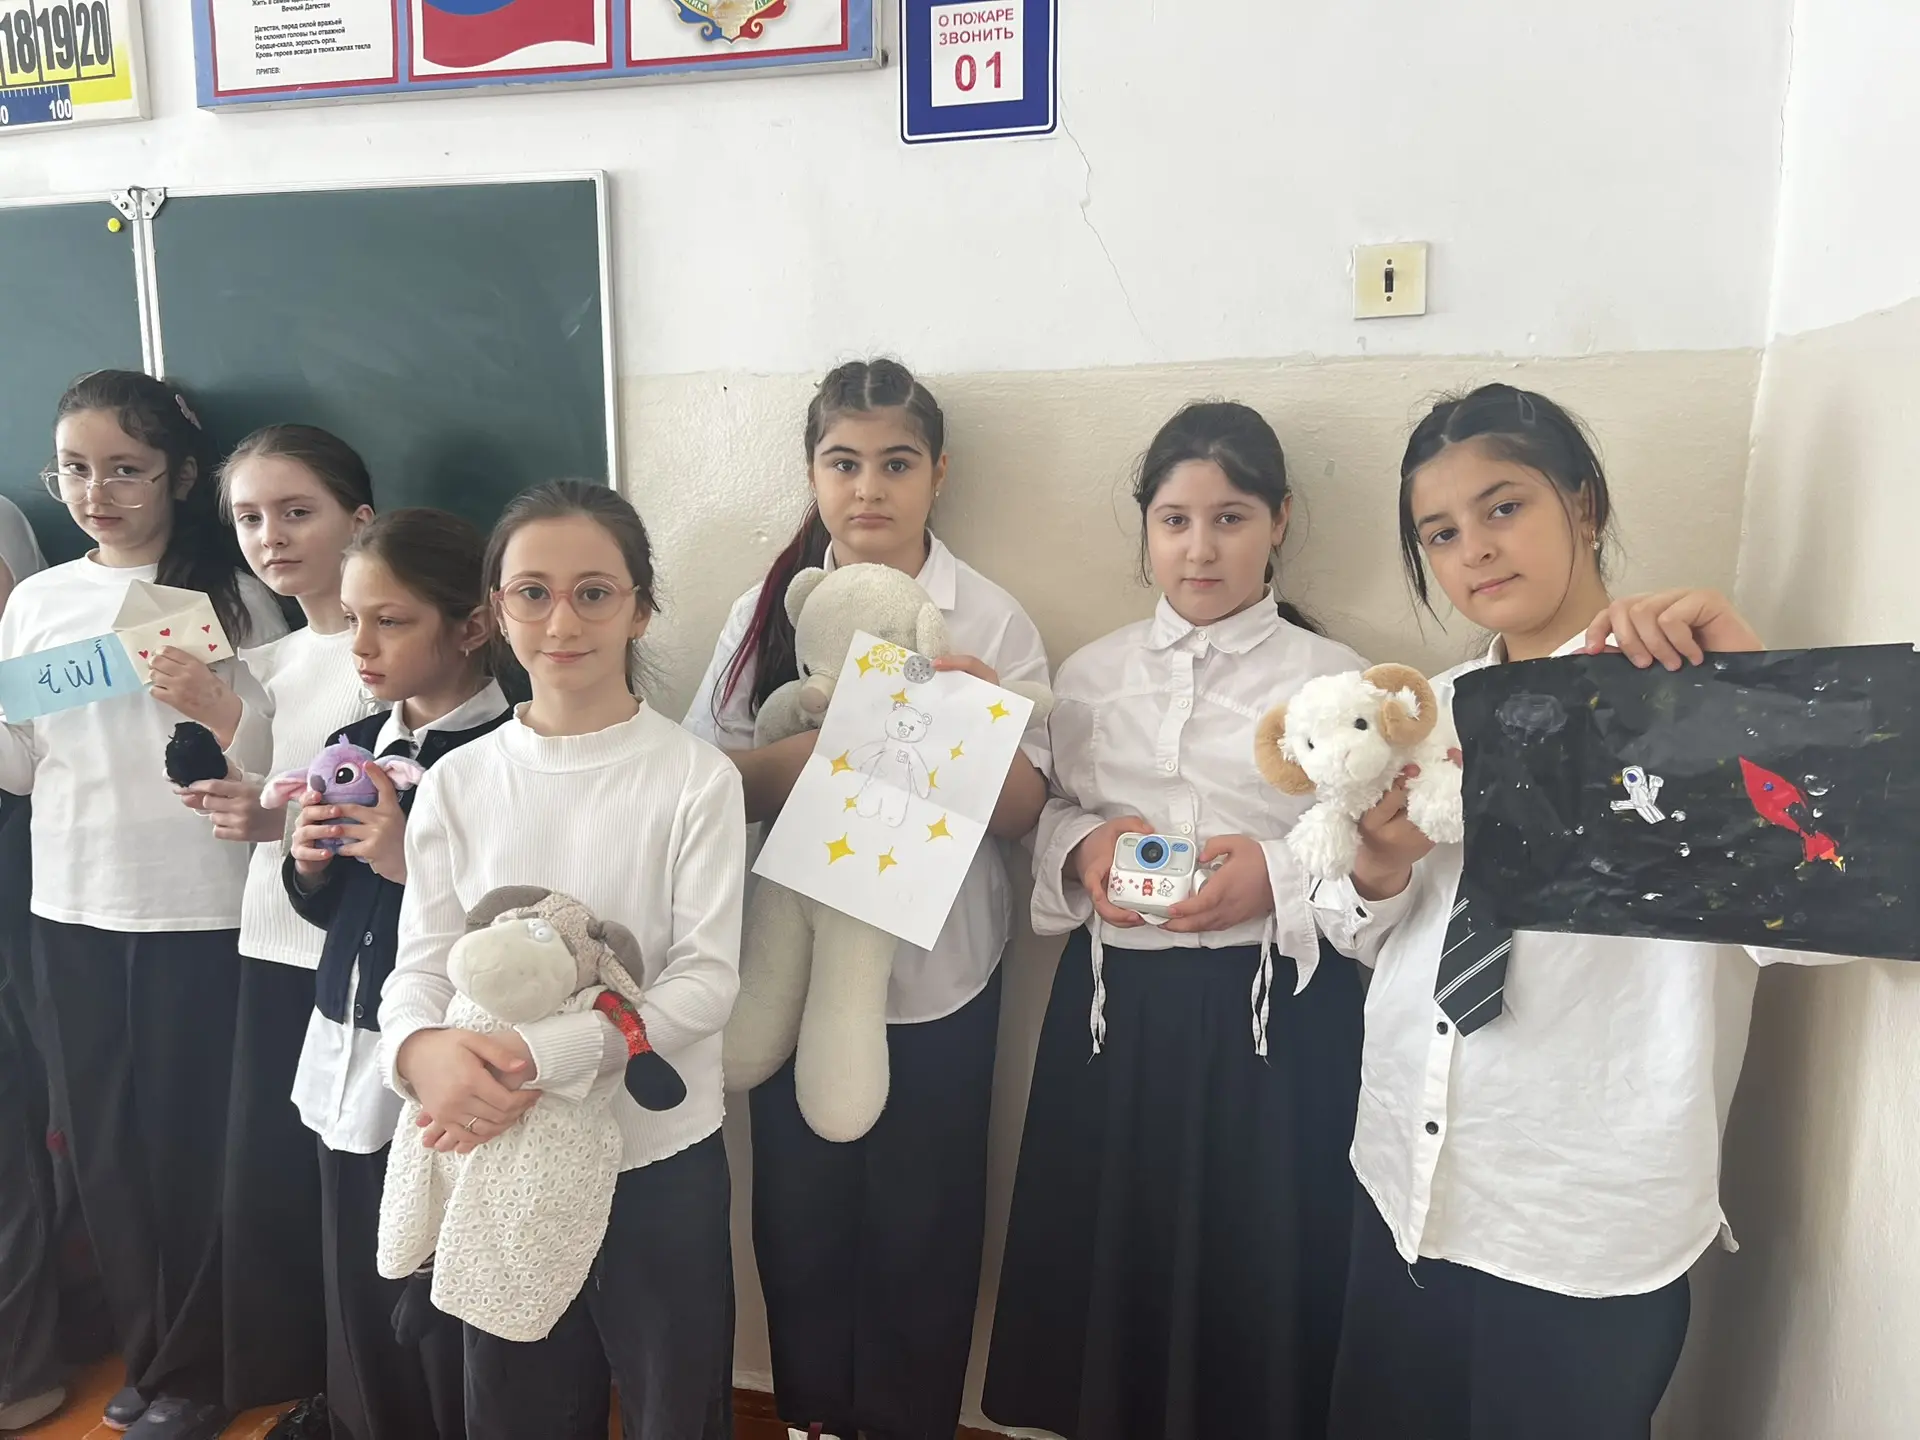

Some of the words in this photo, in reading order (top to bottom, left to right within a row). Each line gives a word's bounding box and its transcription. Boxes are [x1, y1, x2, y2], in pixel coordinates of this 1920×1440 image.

[281, 4, 304, 12] Вечный
[305, 3, 330, 11] Дагестан
[939, 15, 949, 27] О
[953, 8, 1014, 26] ПОЖАРЕ
[281, 23, 299, 31] перед
[299, 20, 316, 28] силой
[317, 18, 342, 27] вражьей
[318, 27, 345, 35] отважной
[939, 27, 1014, 46] ЗВОНИТЬ
[0, 9, 36, 74] 18
[37, 5, 75, 70] 19
[75, 1, 110, 66] 20
[295, 39, 320, 48] зоркость
[255, 51, 273, 59] Кровь
[274, 50, 292, 58] героев
[293, 48, 313, 56] всегда
[256, 67, 280, 75] ПРИПЕВ:
[49, 99, 72, 119] 100
